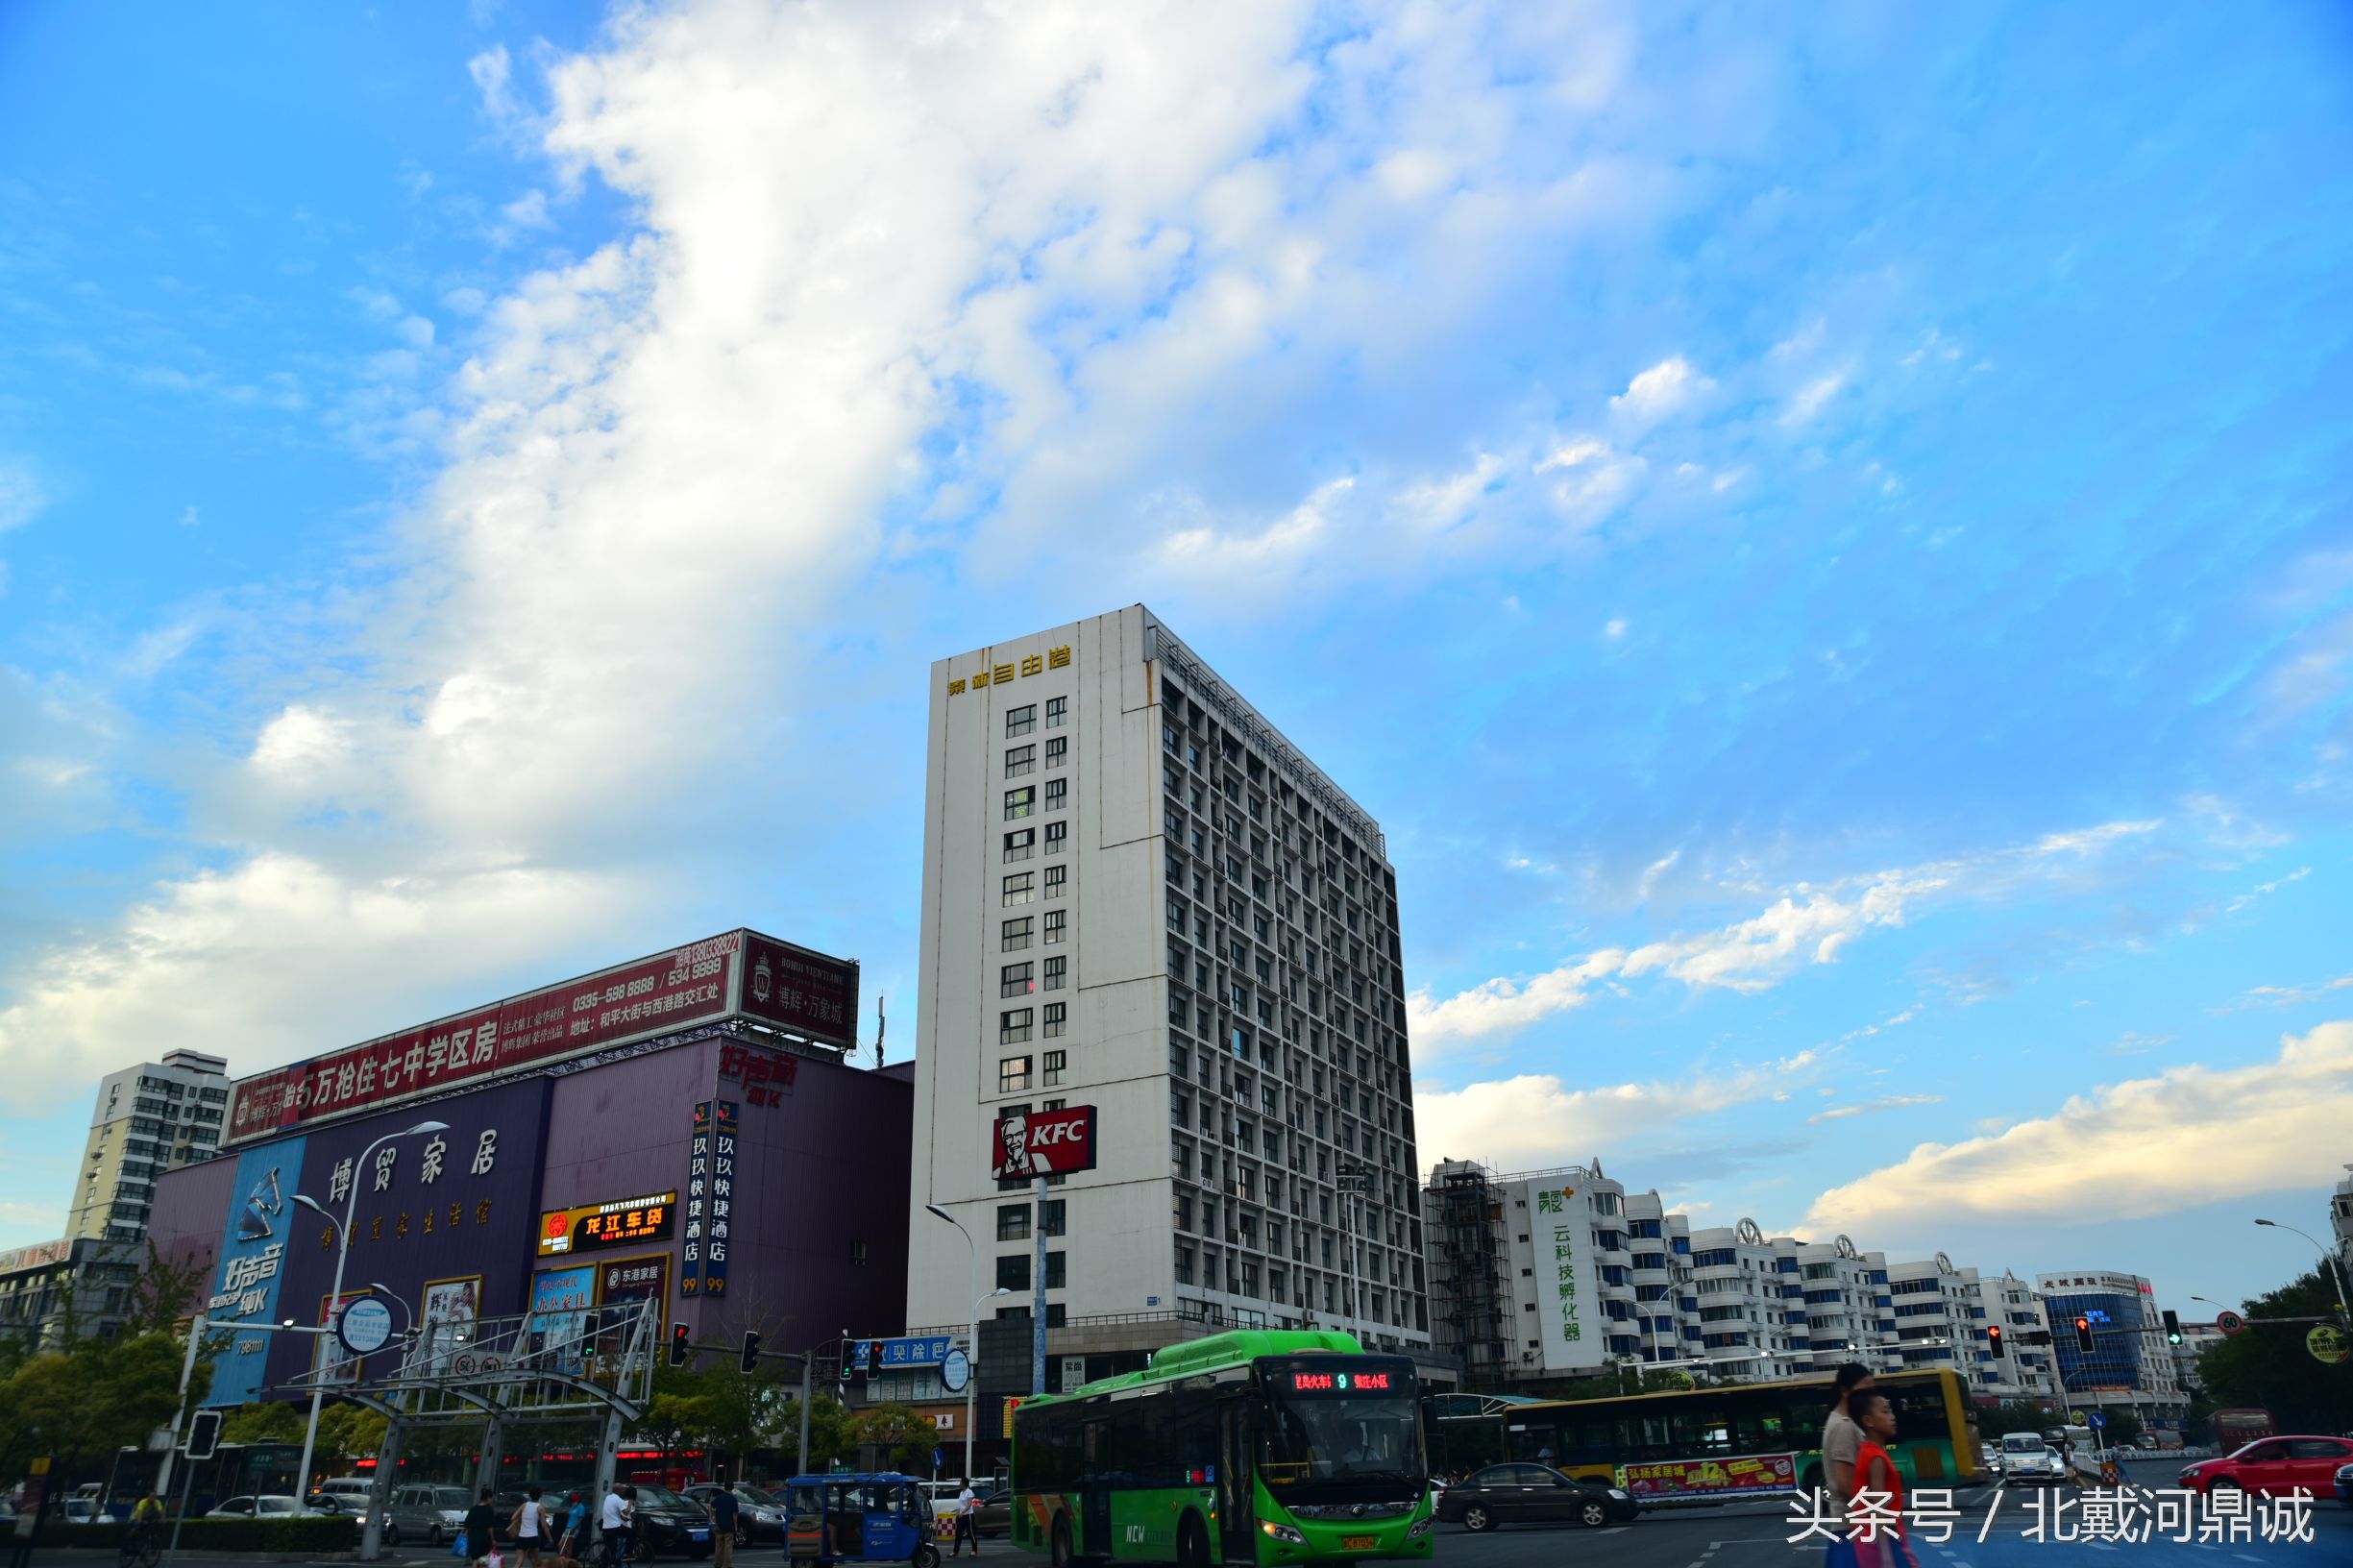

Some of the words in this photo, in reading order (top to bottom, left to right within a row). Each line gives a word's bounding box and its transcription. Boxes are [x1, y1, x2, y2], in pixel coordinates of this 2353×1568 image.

[627, 975, 654, 996] 8888
[692, 957, 722, 978] 9999
[1030, 1119, 1085, 1147] KFC
[684, 1138, 707, 1262] 玖玖快捷酒店
[709, 1137, 734, 1262] 玖玖快捷酒店
[222, 1242, 284, 1296] 好声音
[622, 1266, 658, 1283] 东港家居
[682, 1277, 698, 1292] 99
[707, 1277, 724, 1292] 99
[1553, 1225, 1581, 1342] 云科技孵化器
[2223, 1317, 2237, 1328] 60
[1337, 1374, 1347, 1388] 9
